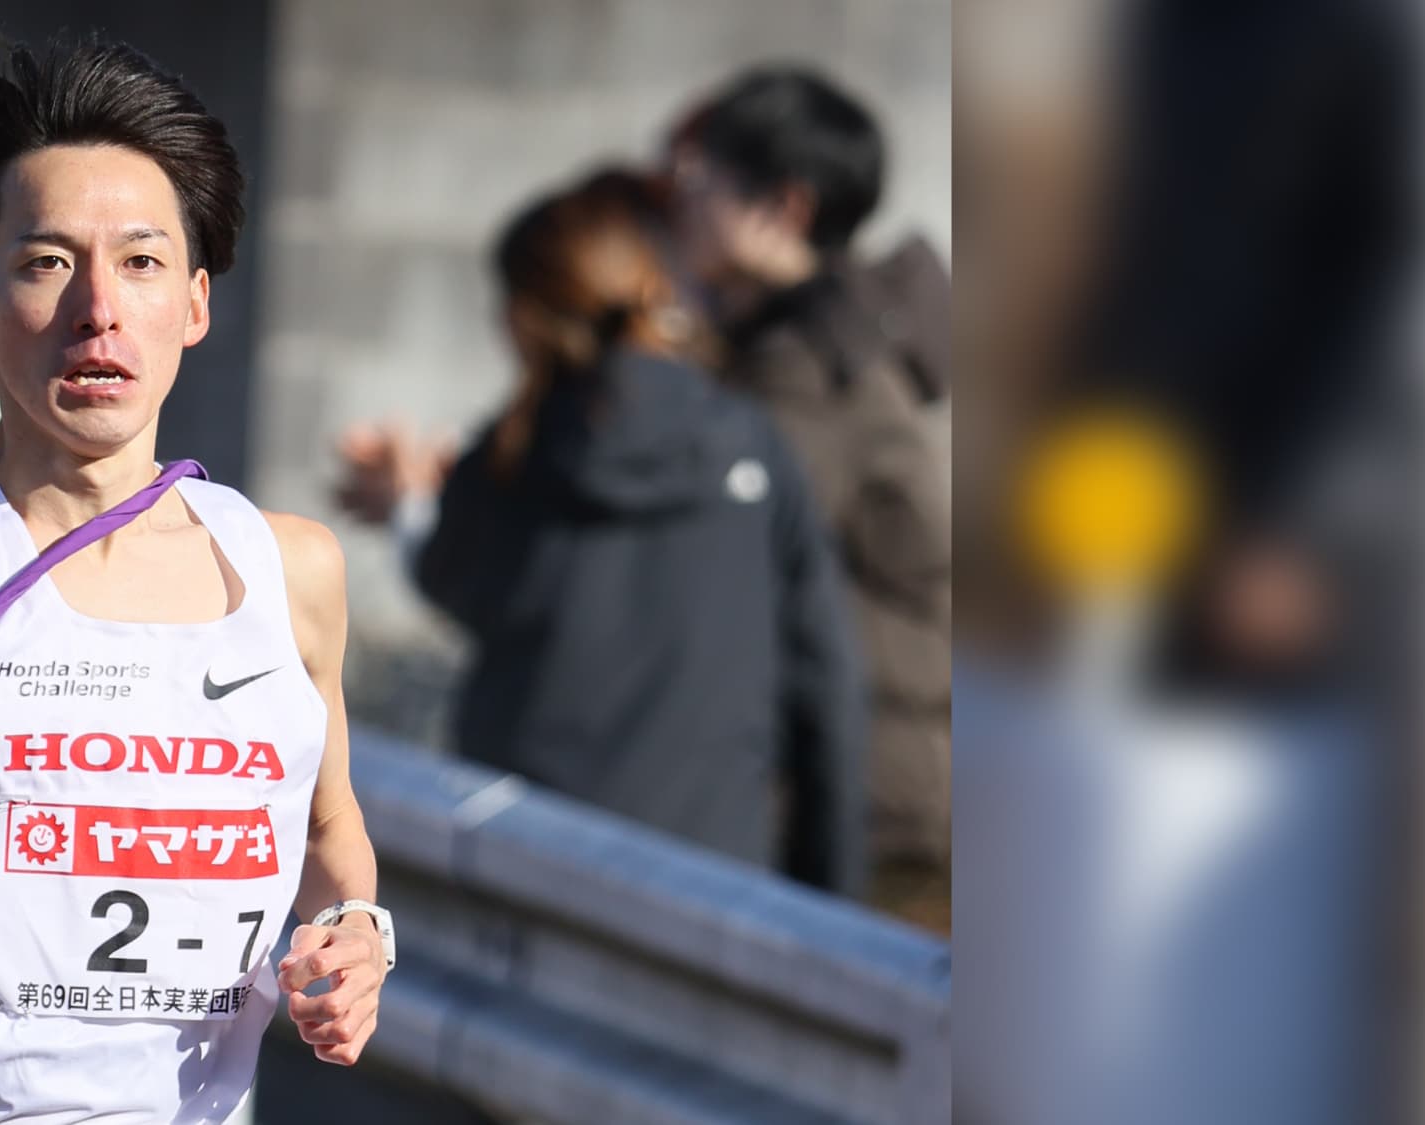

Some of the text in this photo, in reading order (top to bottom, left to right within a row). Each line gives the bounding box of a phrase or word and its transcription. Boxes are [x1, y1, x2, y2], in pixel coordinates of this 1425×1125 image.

[76, 660, 151, 680] Sports
[19, 680, 132, 701] Challenge
[3, 732, 285, 781] HONDA
[88, 821, 273, 866] ヤマザキ
